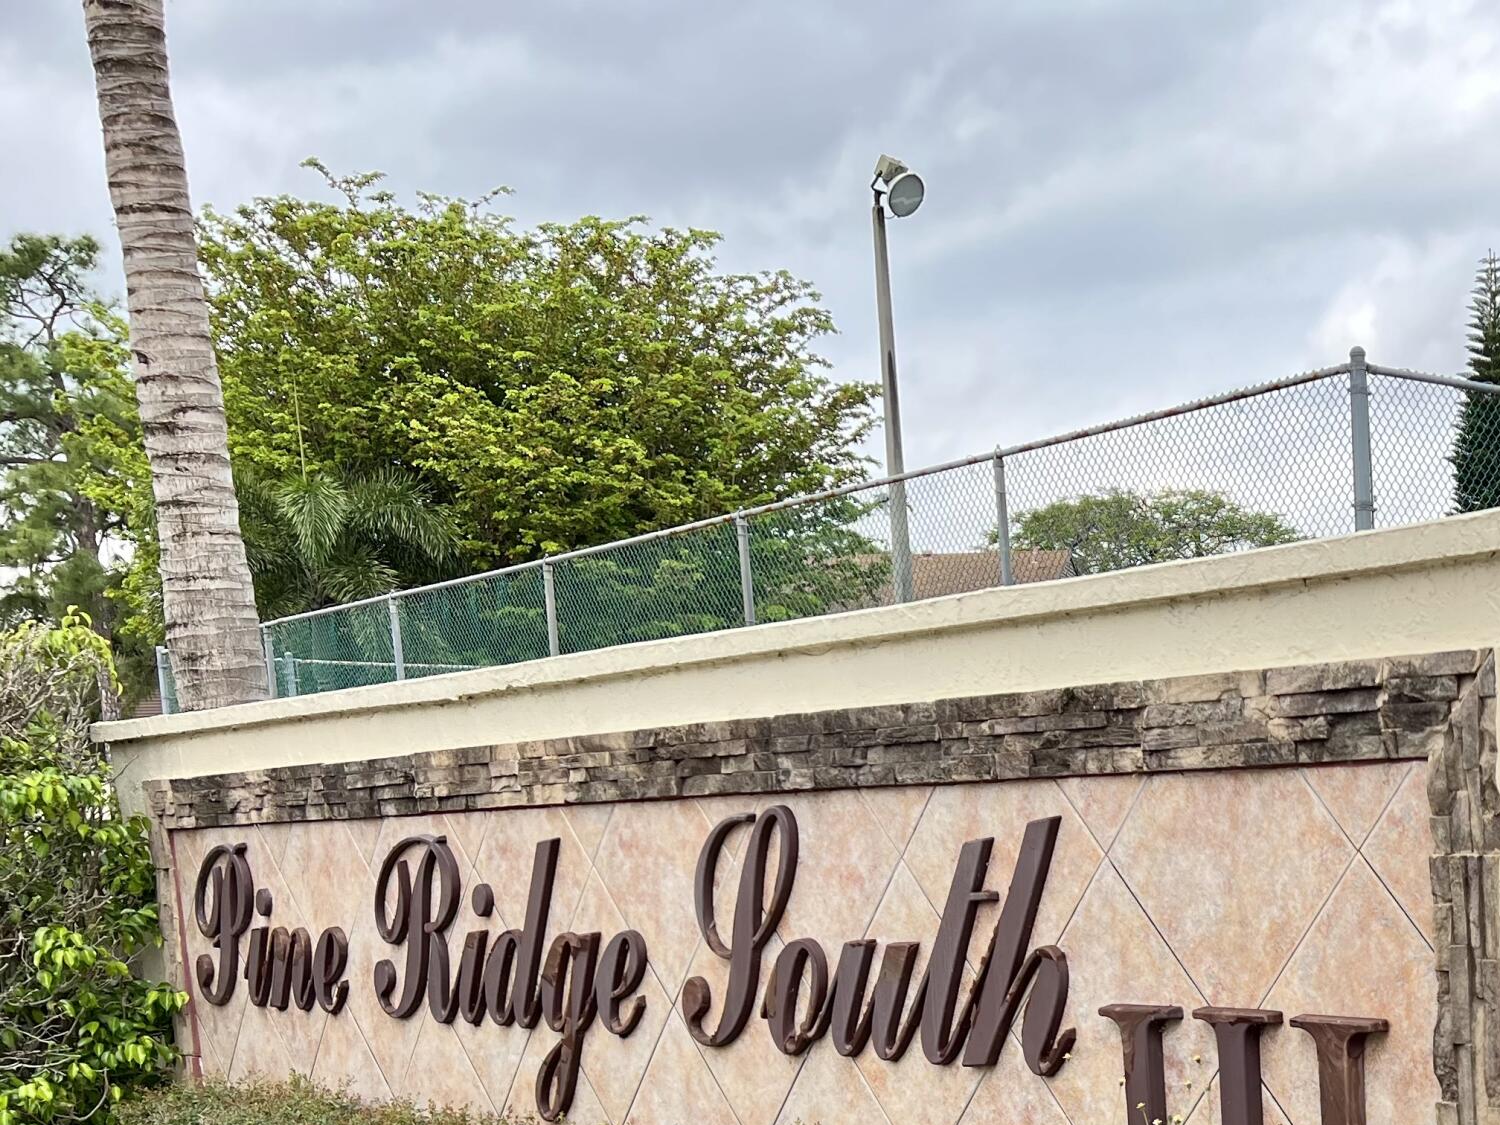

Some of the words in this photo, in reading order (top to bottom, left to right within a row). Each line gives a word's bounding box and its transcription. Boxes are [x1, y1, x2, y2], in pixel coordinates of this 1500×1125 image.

[195, 842, 350, 1015] Pine
[373, 834, 648, 1123] Ridge
[682, 804, 1077, 1078] South
